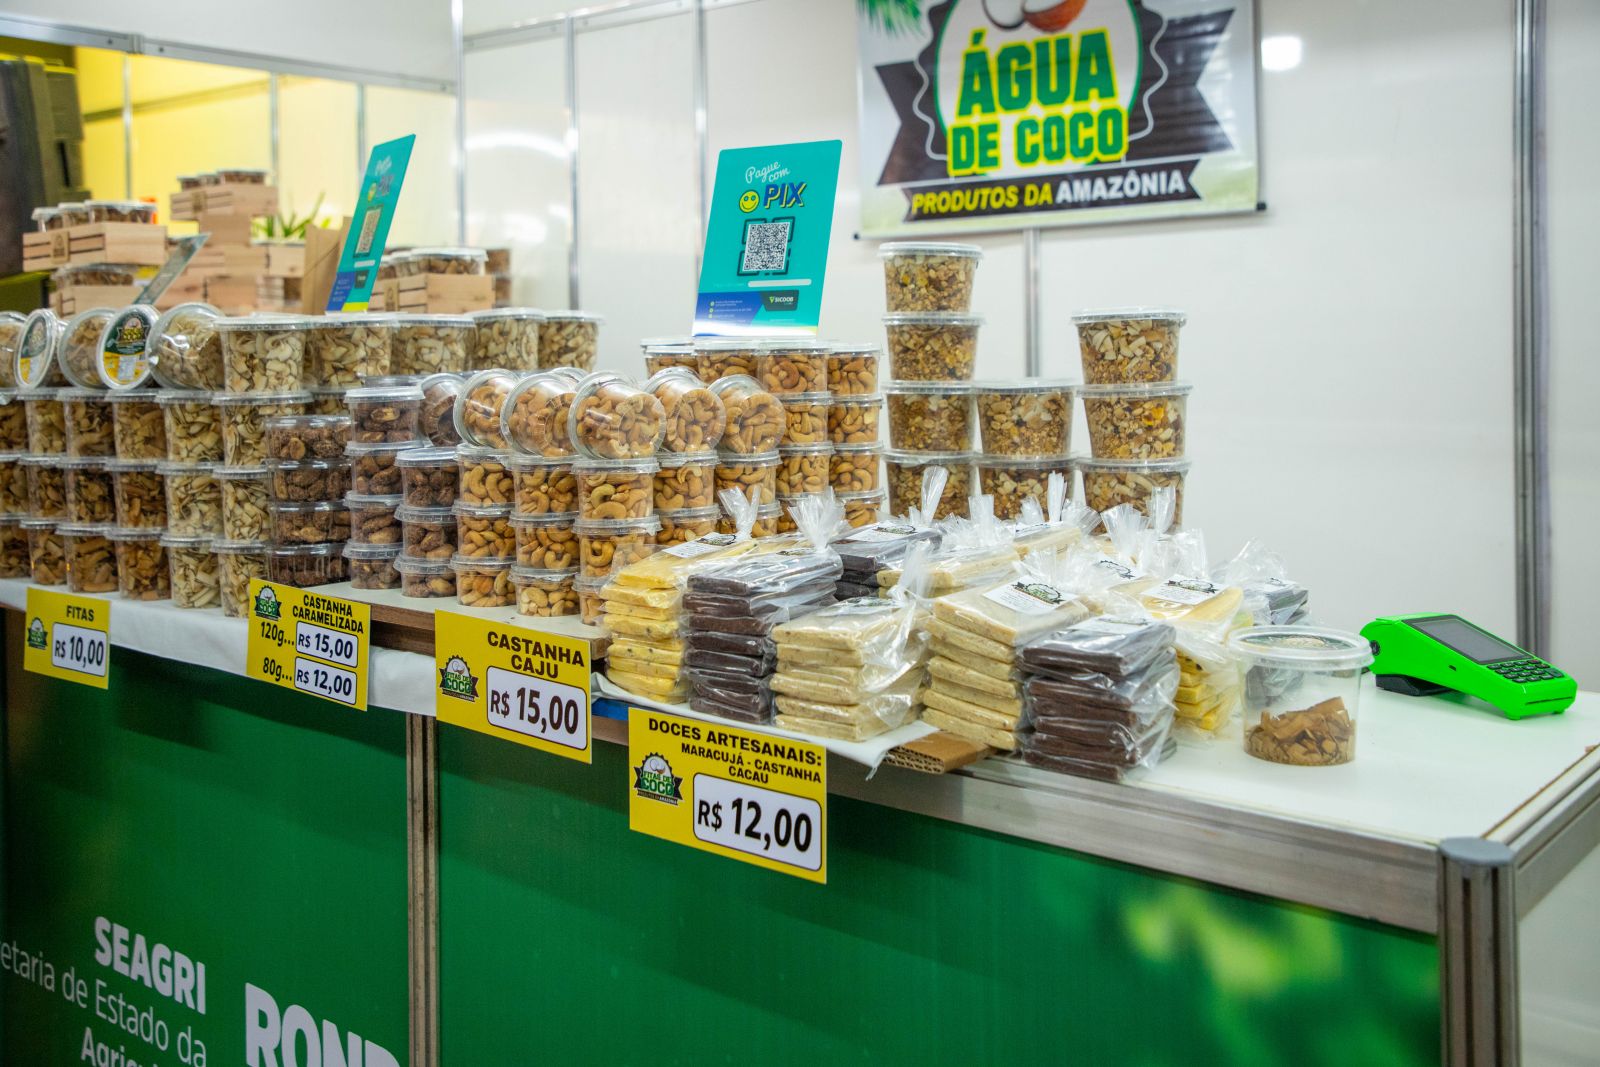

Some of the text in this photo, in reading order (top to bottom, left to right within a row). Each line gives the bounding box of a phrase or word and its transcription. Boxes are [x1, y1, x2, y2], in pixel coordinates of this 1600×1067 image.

[957, 27, 1116, 118] ÁGUA
[947, 105, 1128, 176] DE COCO
[745, 161, 780, 183] Pague
[768, 168, 790, 182] com
[763, 181, 807, 210] PIX
[911, 169, 1186, 214] PRODUTOS DA AMAZÔNIA
[66, 605, 95, 622] FITAS
[292, 605, 364, 634] CARAMELIZADA
[303, 594, 353, 617] CASTANHA
[260, 621, 295, 647] 120g...
[298, 633, 353, 659] R$ 15,00
[54, 640, 66, 658] R$
[70, 636, 104, 668] 10,00
[487, 631, 585, 667] CASTANHA
[262, 657, 292, 682] 80g...
[511, 654, 559, 679] CAJU
[297, 669, 352, 696] R$ 12,00
[445, 678, 472, 694] COCO
[490, 687, 579, 735] R$ 15,00
[649, 718, 822, 766] DOCES ARTESANAIS:
[681, 743, 744, 766] MARACUJÁ
[754, 759, 821, 783] CASTANHA
[728, 765, 769, 784] CACAU
[641, 778, 674, 796] COCO
[698, 797, 812, 852] R$ 12,00
[95, 916, 206, 1015] SEAGRI
[0, 940, 206, 1067] etaria de Estado da
